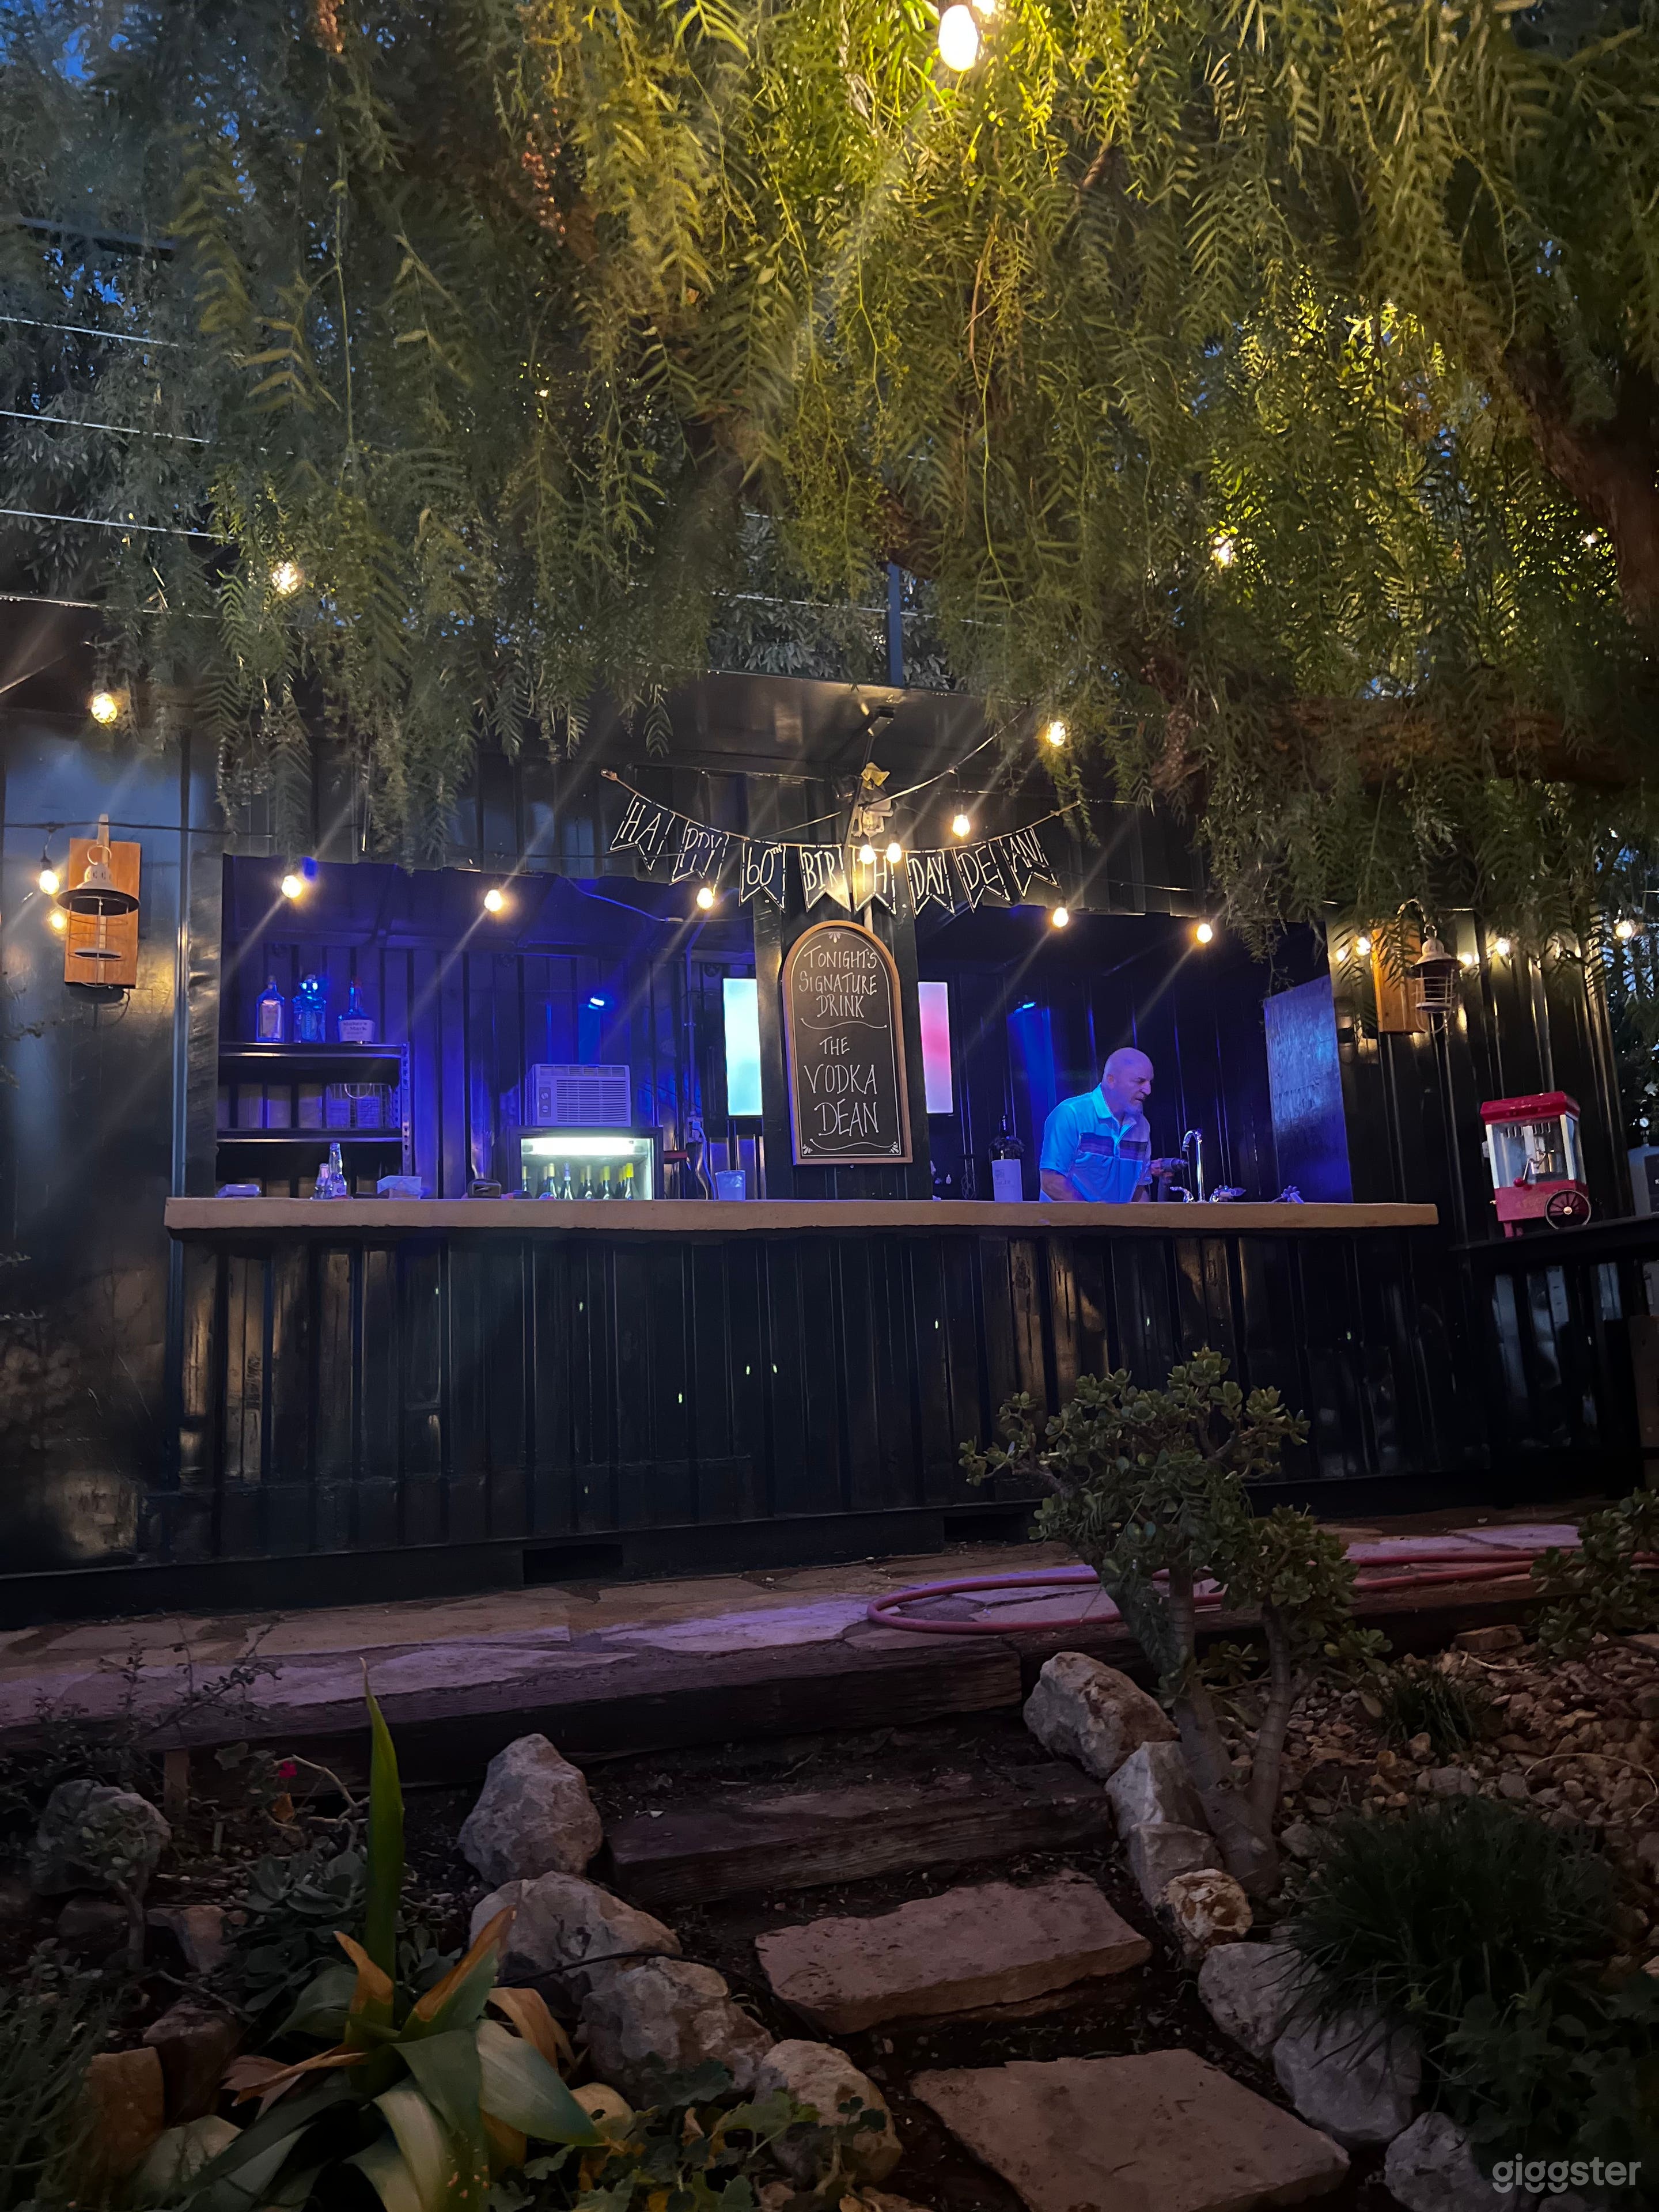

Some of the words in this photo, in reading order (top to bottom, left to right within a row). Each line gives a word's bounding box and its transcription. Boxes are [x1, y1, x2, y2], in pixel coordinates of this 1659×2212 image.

[804, 945, 877, 969] TONIGHT'S
[799, 970, 877, 995] SIGNATURE
[816, 994, 864, 1018] DRINK
[819, 1036, 850, 1055] THE
[804, 1064, 877, 1094] VODKA
[814, 1099, 880, 1137] DEAN
